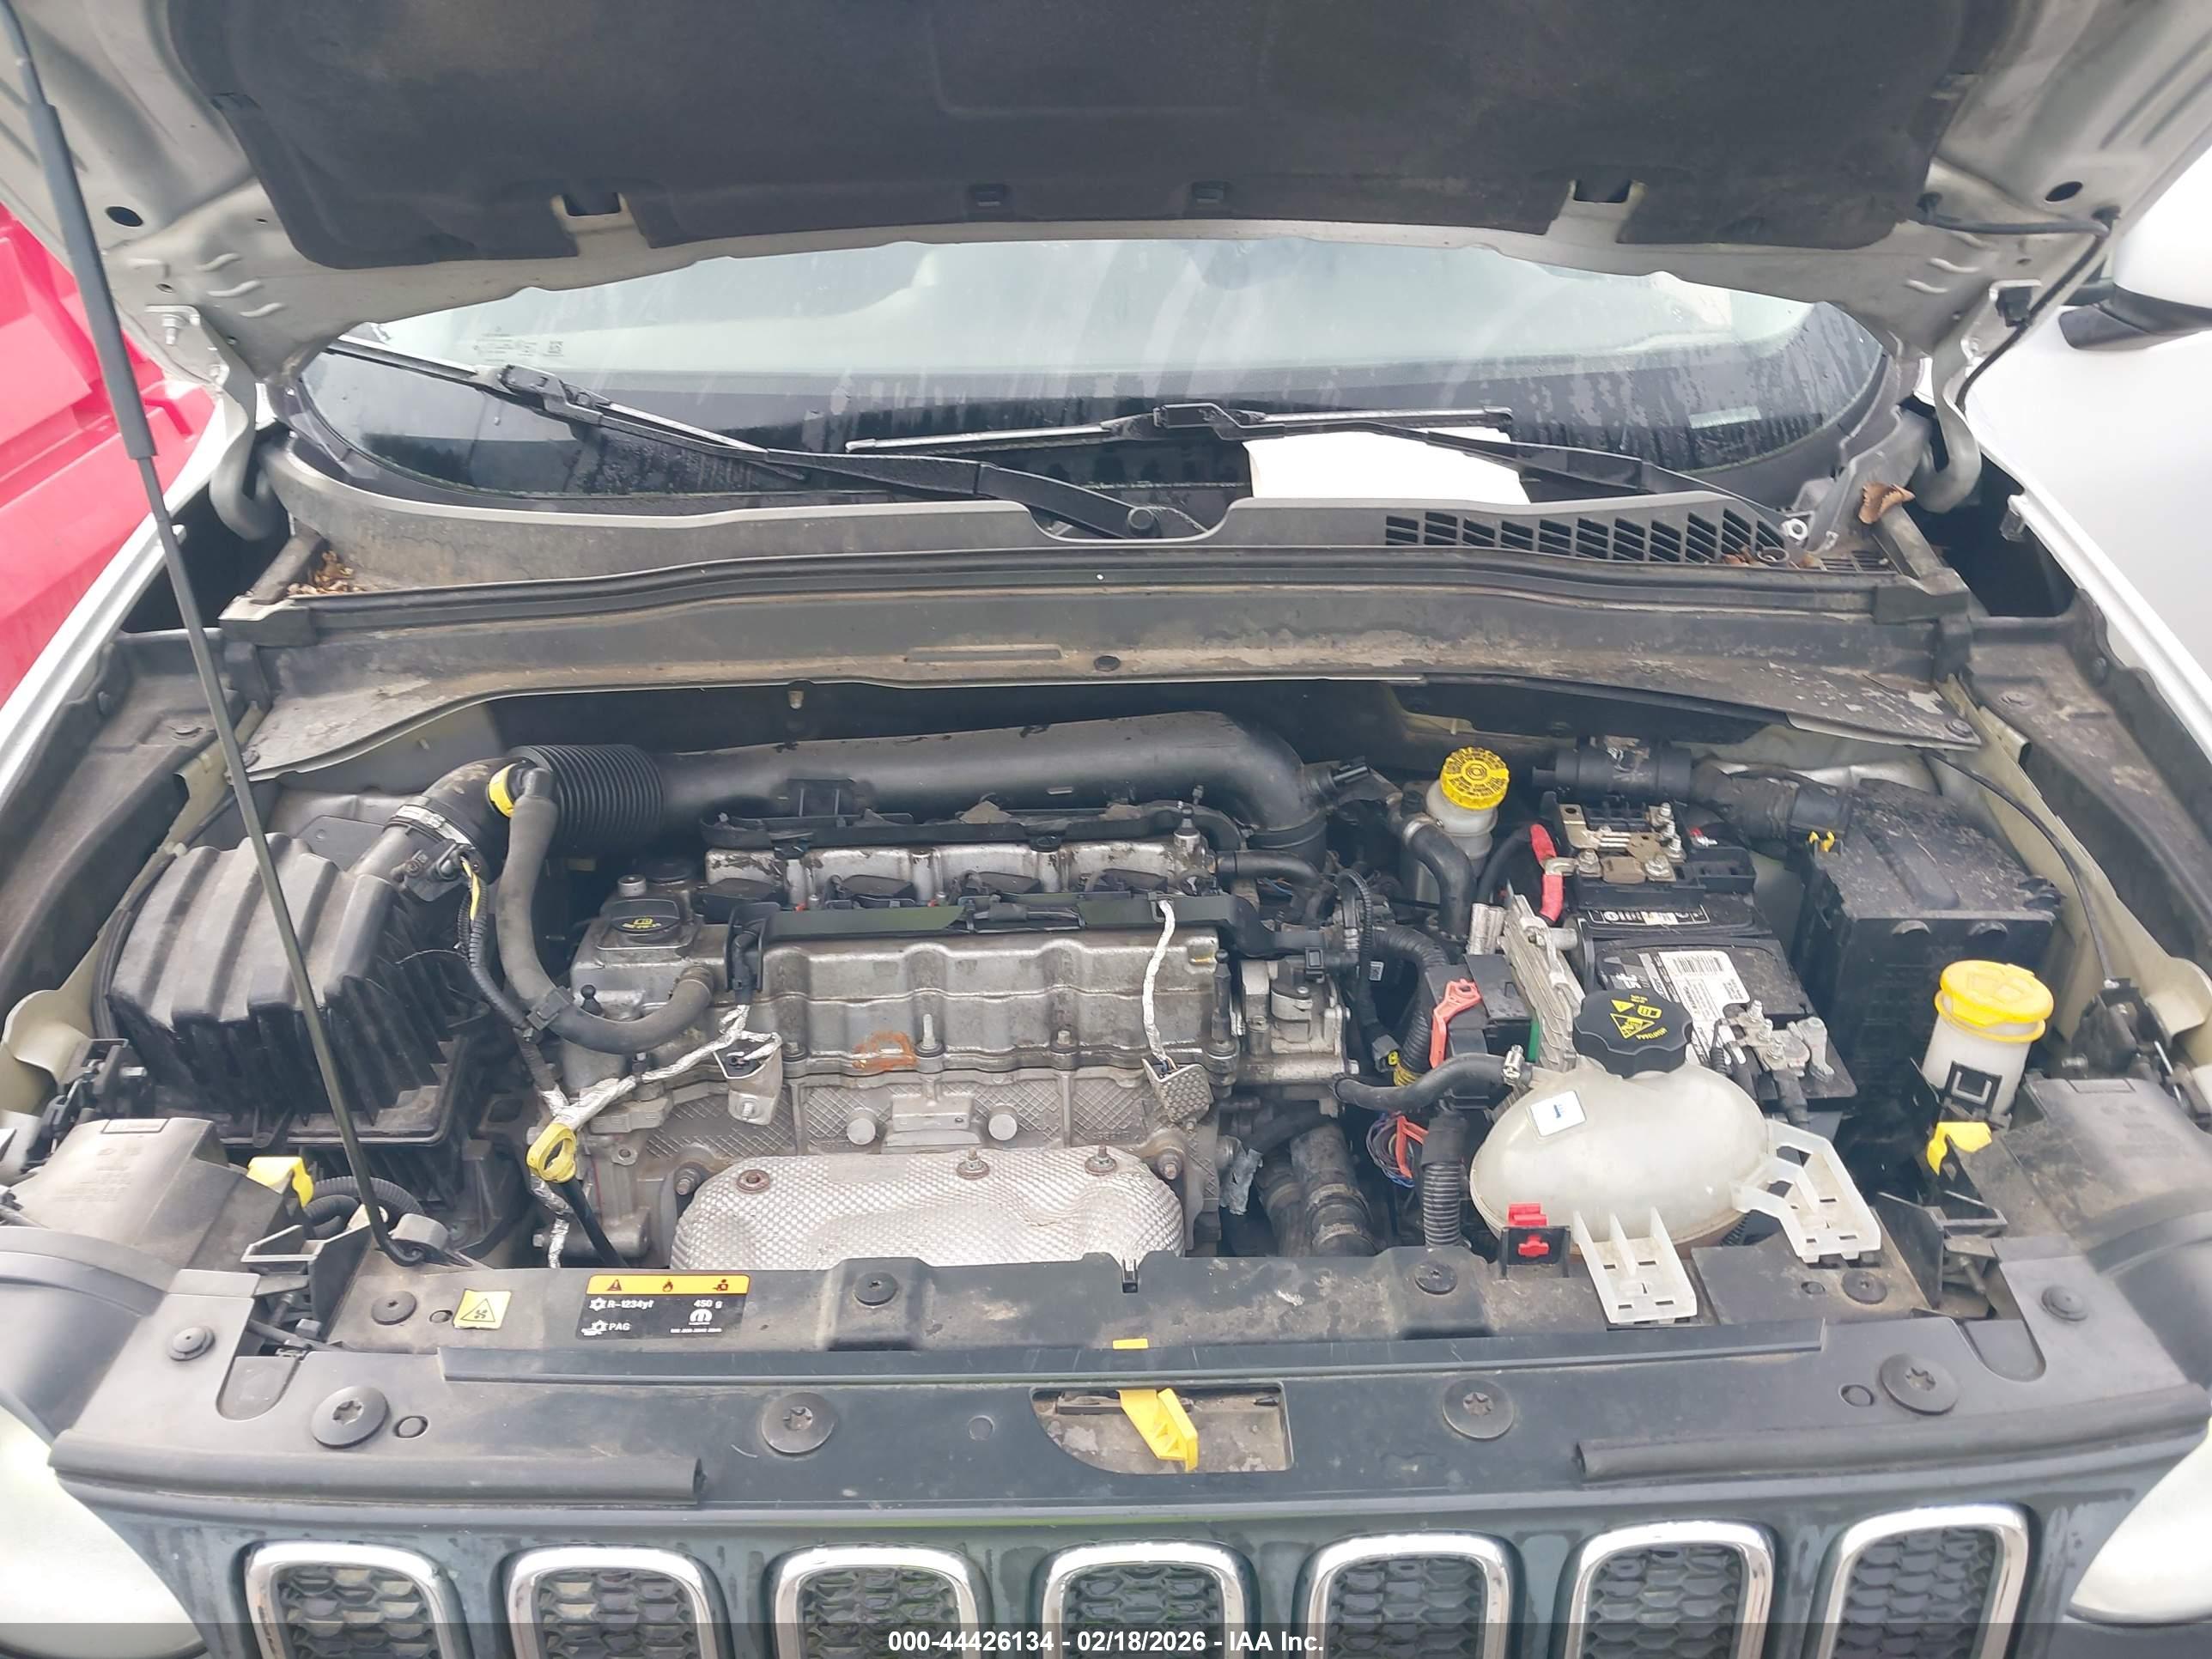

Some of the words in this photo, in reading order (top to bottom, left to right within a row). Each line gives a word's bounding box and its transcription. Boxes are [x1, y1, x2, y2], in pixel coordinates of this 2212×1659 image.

[607, 1300, 654, 1310] R-1234yf
[693, 1299, 713, 1308] 450
[608, 1322, 631, 1331] PAG
